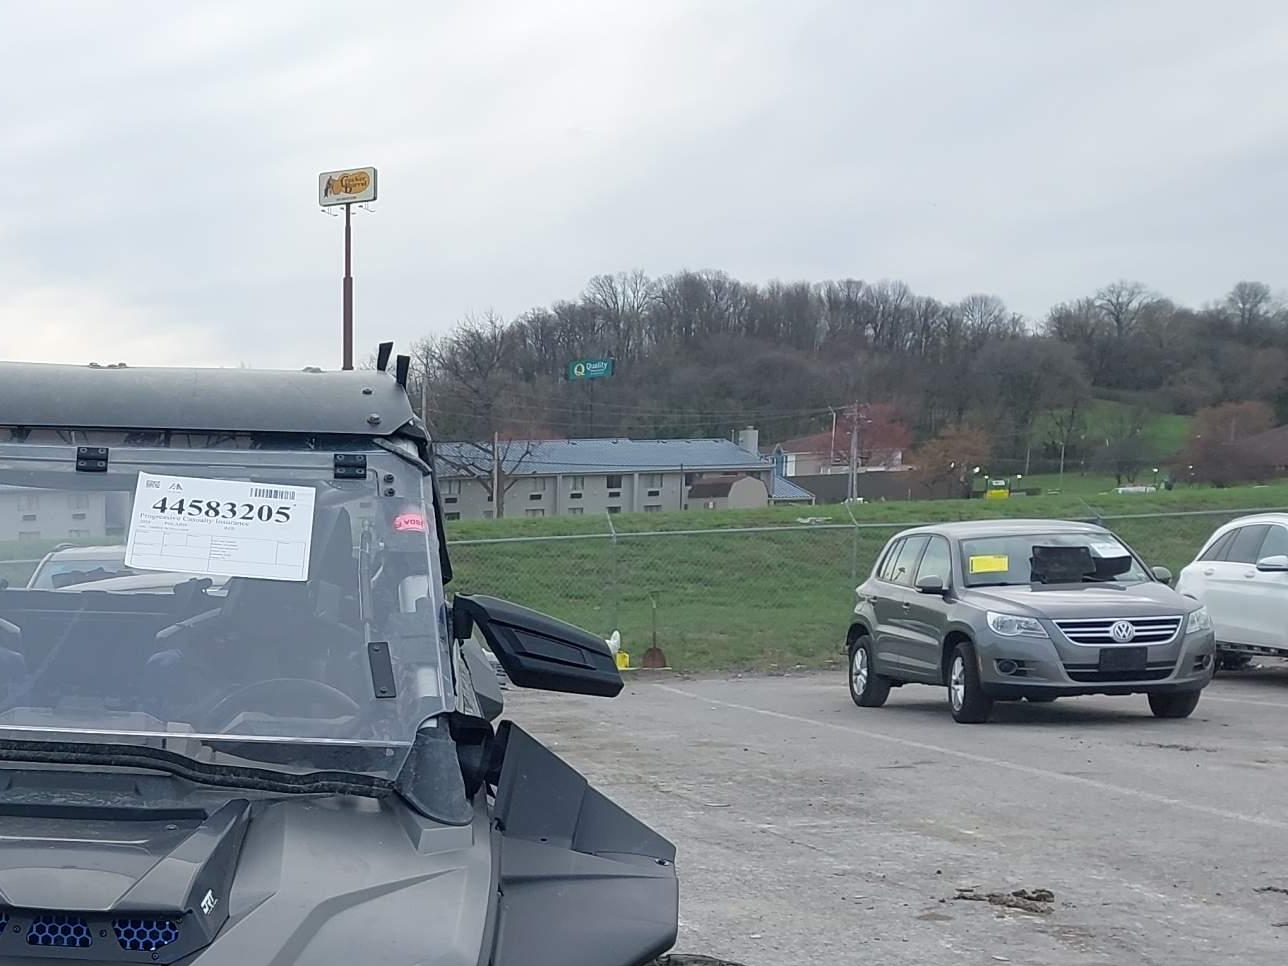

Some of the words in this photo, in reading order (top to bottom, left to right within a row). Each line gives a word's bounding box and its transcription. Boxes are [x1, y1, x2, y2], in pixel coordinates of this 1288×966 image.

[340, 175, 366, 188] Cracker
[344, 181, 367, 193] Barrel
[586, 361, 608, 371] Quality
[152, 496, 291, 523] 44583205
